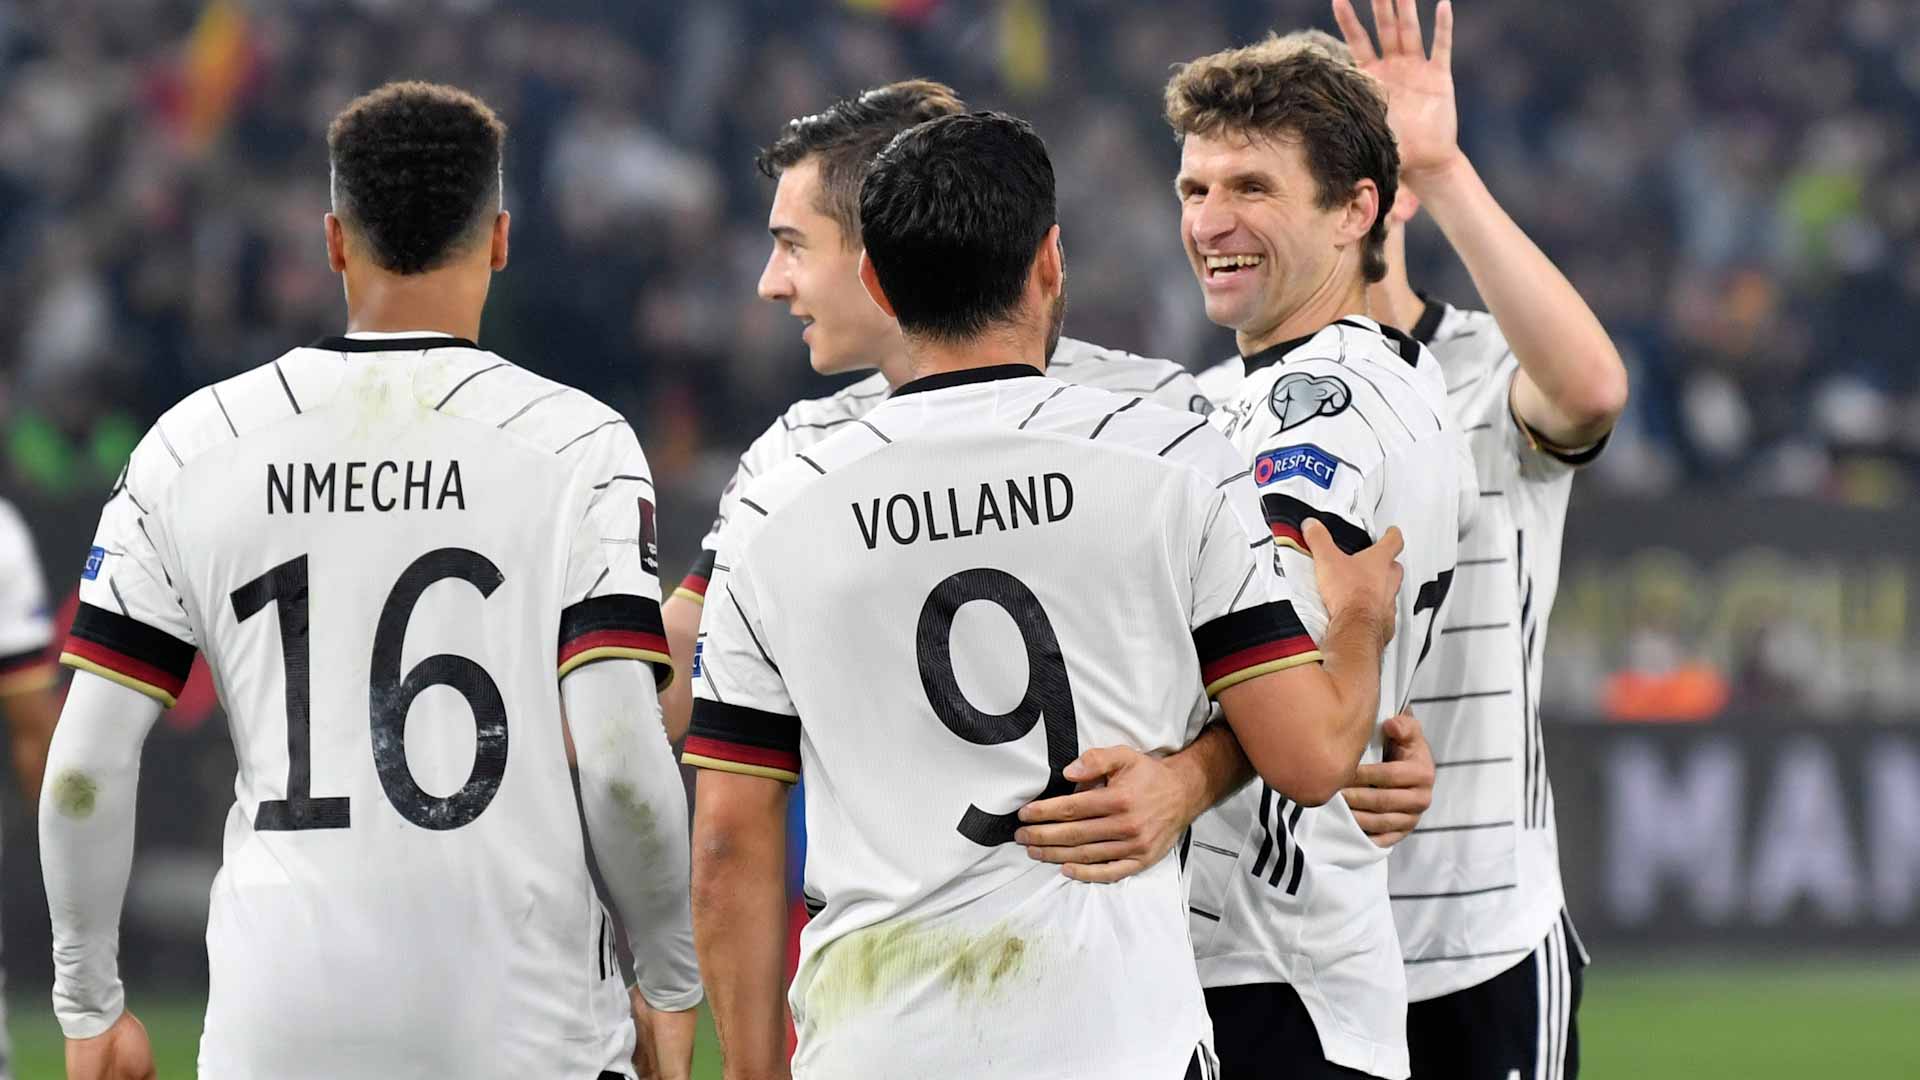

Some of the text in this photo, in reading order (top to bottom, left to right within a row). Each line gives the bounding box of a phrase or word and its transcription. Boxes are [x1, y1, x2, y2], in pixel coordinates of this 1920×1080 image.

[267, 460, 467, 515] NMECHA
[1273, 454, 1335, 481] RESPECT
[851, 472, 1074, 550] VOLLAND
[229, 547, 510, 832] 16
[915, 567, 1080, 848] 9
